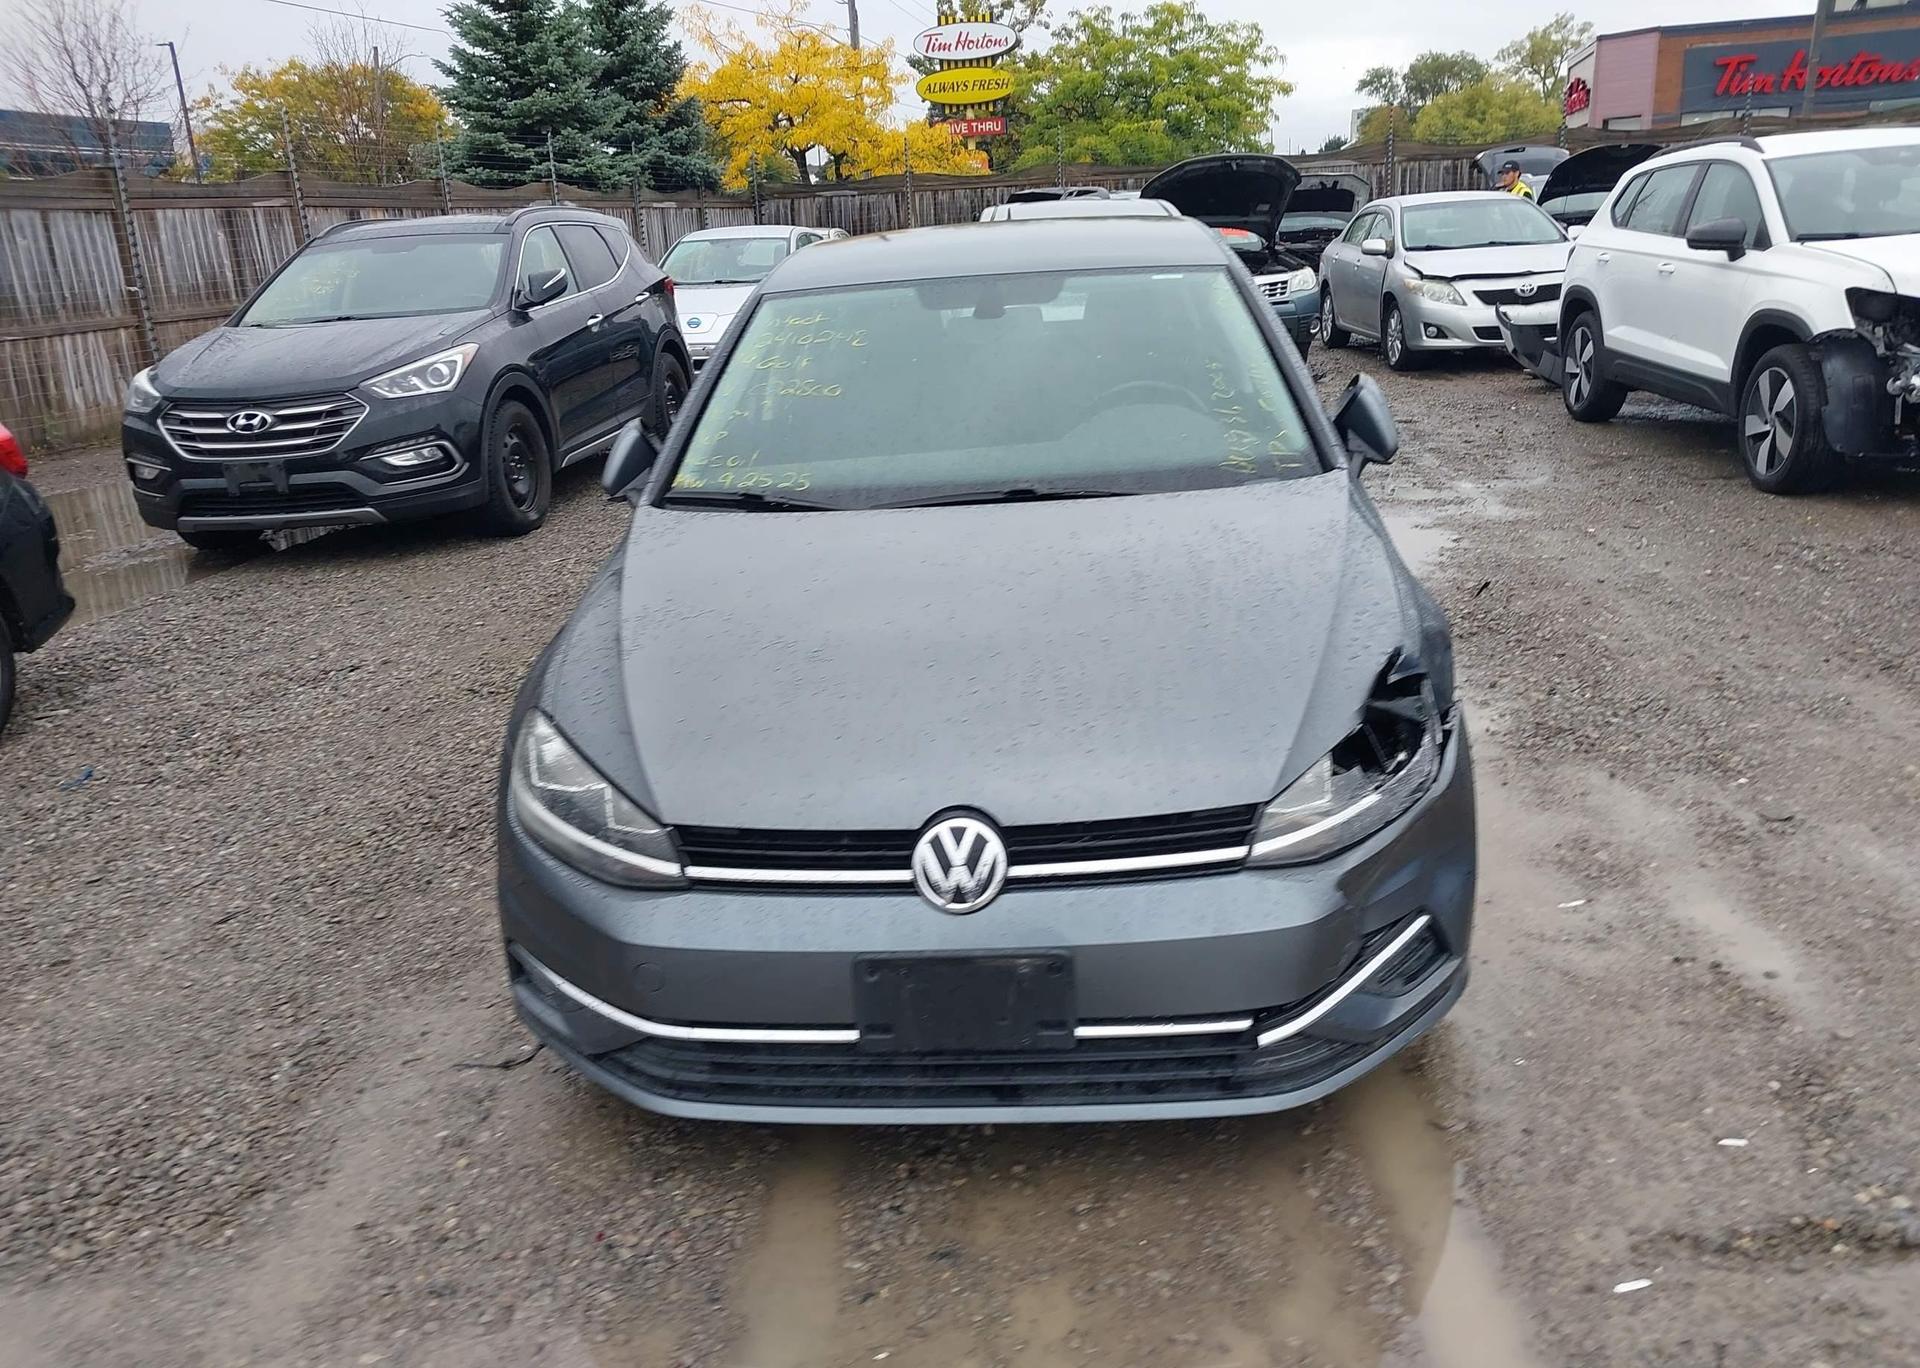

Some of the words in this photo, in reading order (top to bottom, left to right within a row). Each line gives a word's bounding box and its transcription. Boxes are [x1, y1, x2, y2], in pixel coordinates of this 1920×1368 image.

[923, 32, 953, 54] Tim
[955, 30, 1009, 51] Hortons
[1714, 53, 1776, 97] Tim
[923, 80, 969, 95] ALWAYS
[971, 78, 1010, 92] FRESH
[948, 122, 968, 134] IVE
[971, 120, 1001, 132] THRU
